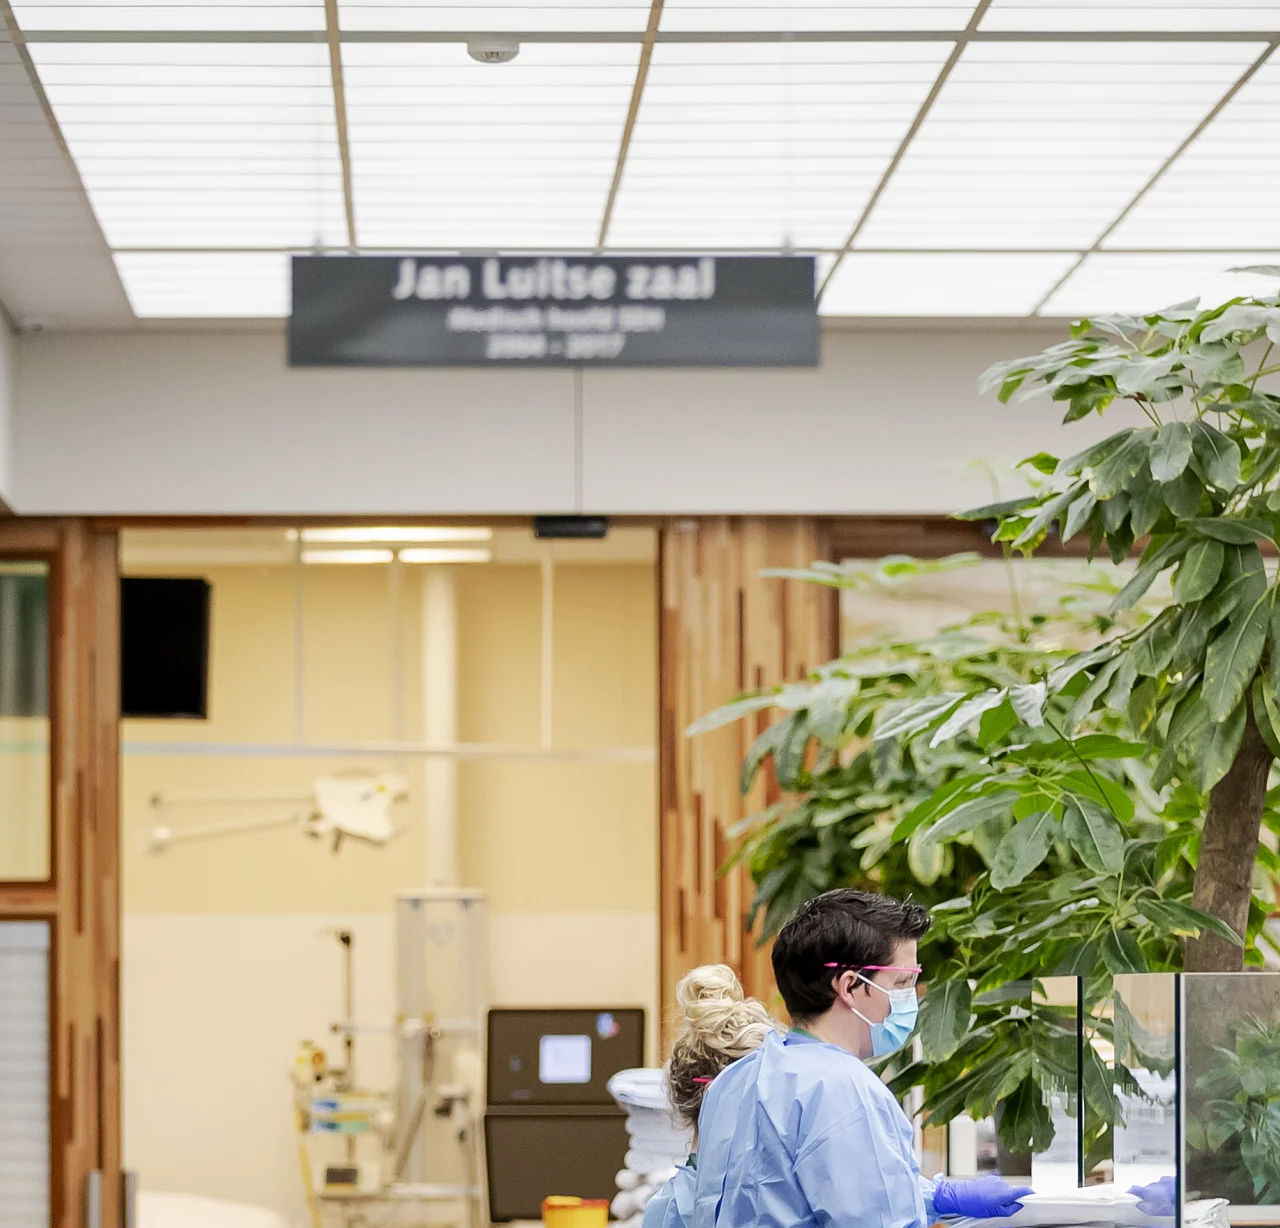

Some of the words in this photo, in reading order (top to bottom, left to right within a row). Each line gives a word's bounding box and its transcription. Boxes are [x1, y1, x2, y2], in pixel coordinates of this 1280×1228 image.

[393, 258, 470, 299] Jan
[483, 258, 617, 299] Luitse
[626, 258, 716, 299] zaal
